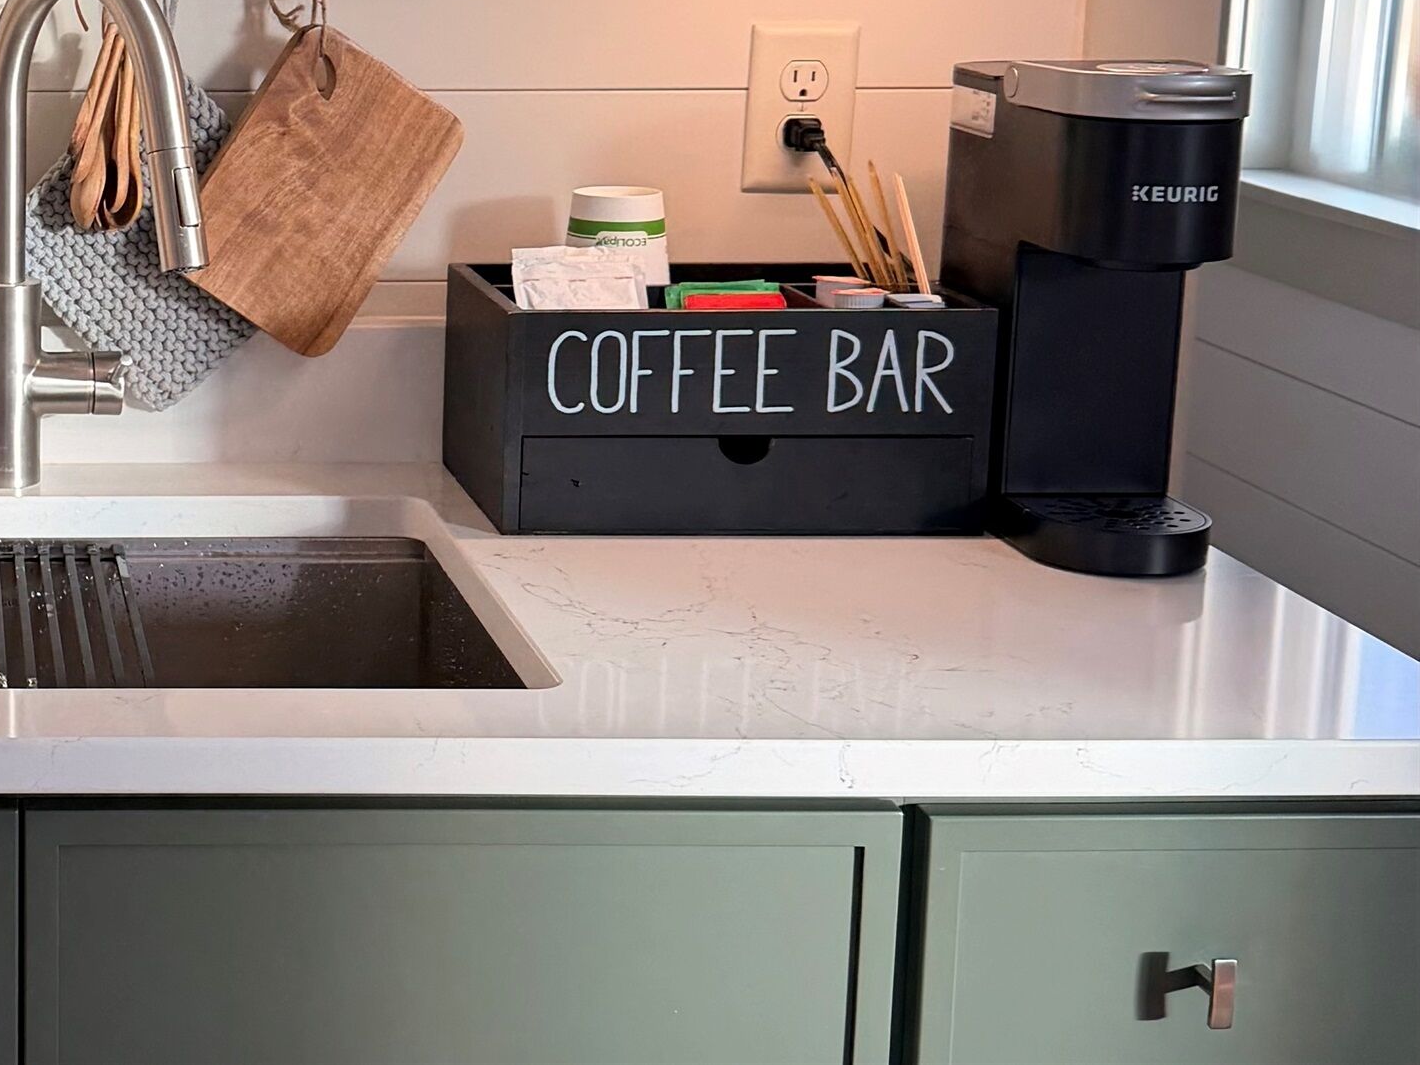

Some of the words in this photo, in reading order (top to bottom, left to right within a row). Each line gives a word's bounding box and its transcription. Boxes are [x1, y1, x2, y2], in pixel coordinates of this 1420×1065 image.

[1131, 184, 1219, 203] KEURIG
[547, 328, 798, 415] COFFEE
[825, 328, 956, 415] BAR
